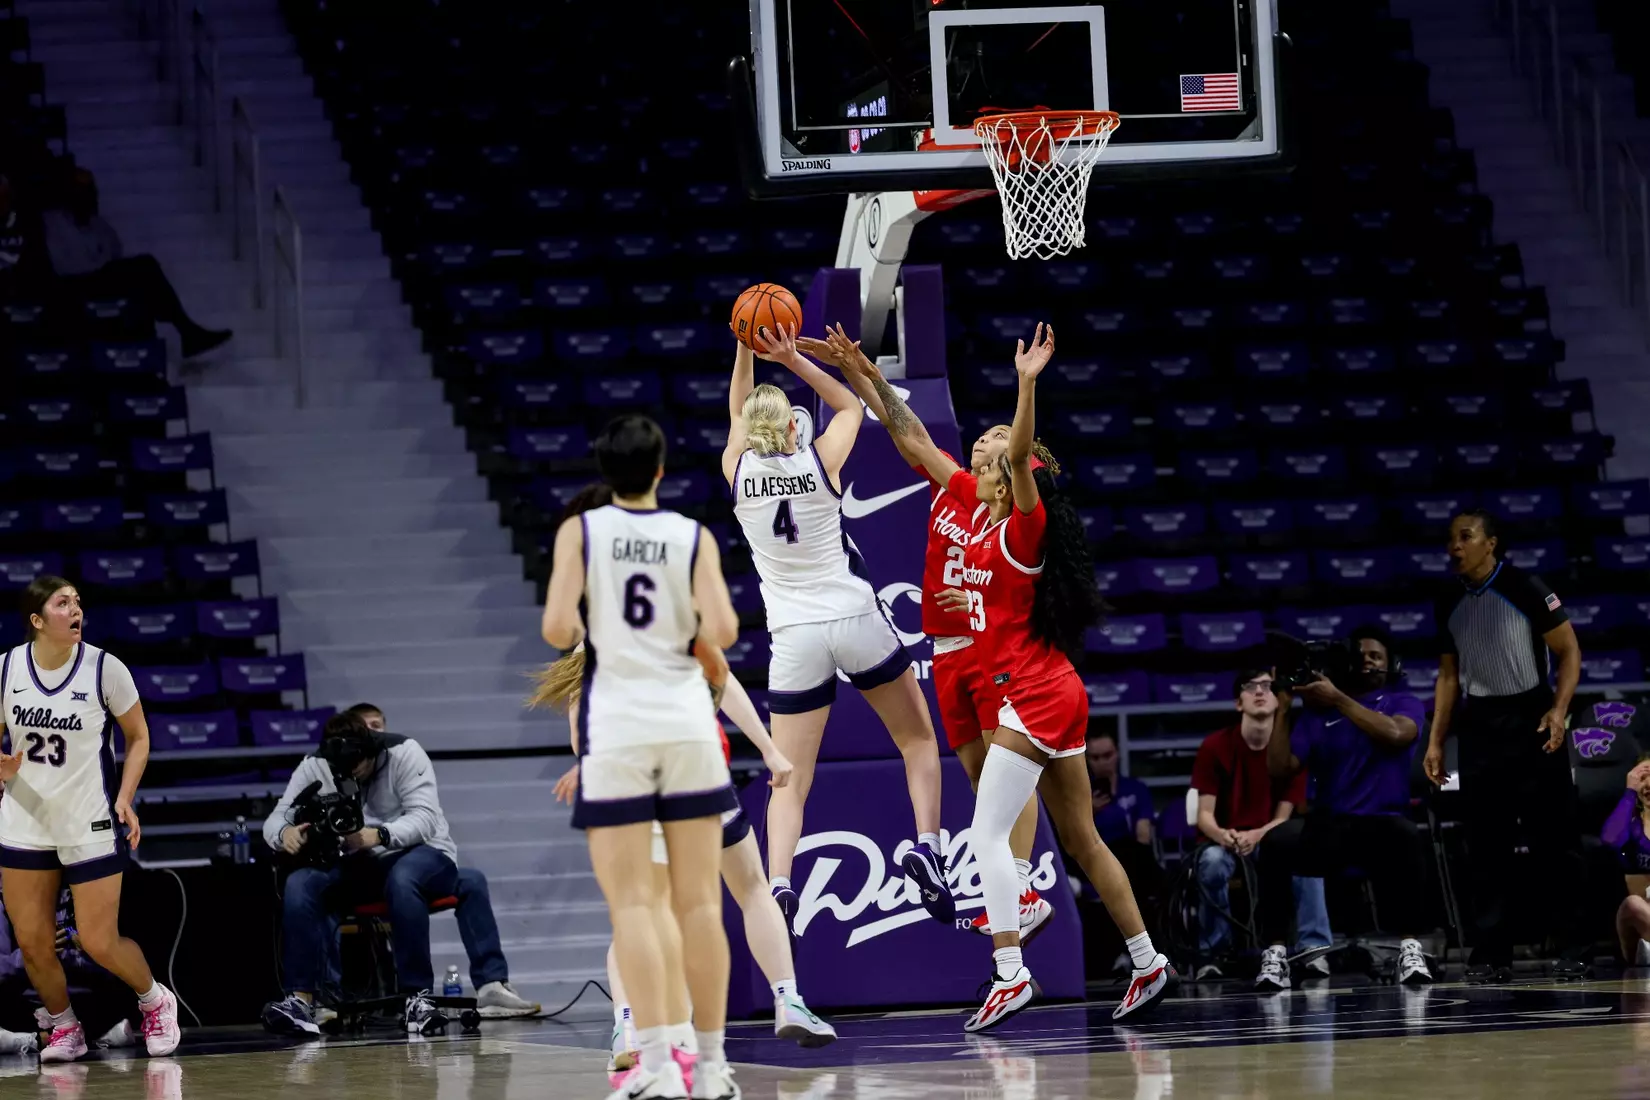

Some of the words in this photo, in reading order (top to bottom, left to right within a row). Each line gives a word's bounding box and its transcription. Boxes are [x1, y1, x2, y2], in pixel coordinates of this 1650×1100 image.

[782, 159, 831, 172] SPALDING
[744, 473, 816, 498] CLAESSENS
[772, 498, 799, 544] 4
[933, 506, 971, 546] Hous
[613, 537, 668, 565] GARCIA
[624, 573, 656, 629] 6
[12, 704, 83, 731] Wildcats
[25, 732, 67, 768] 23
